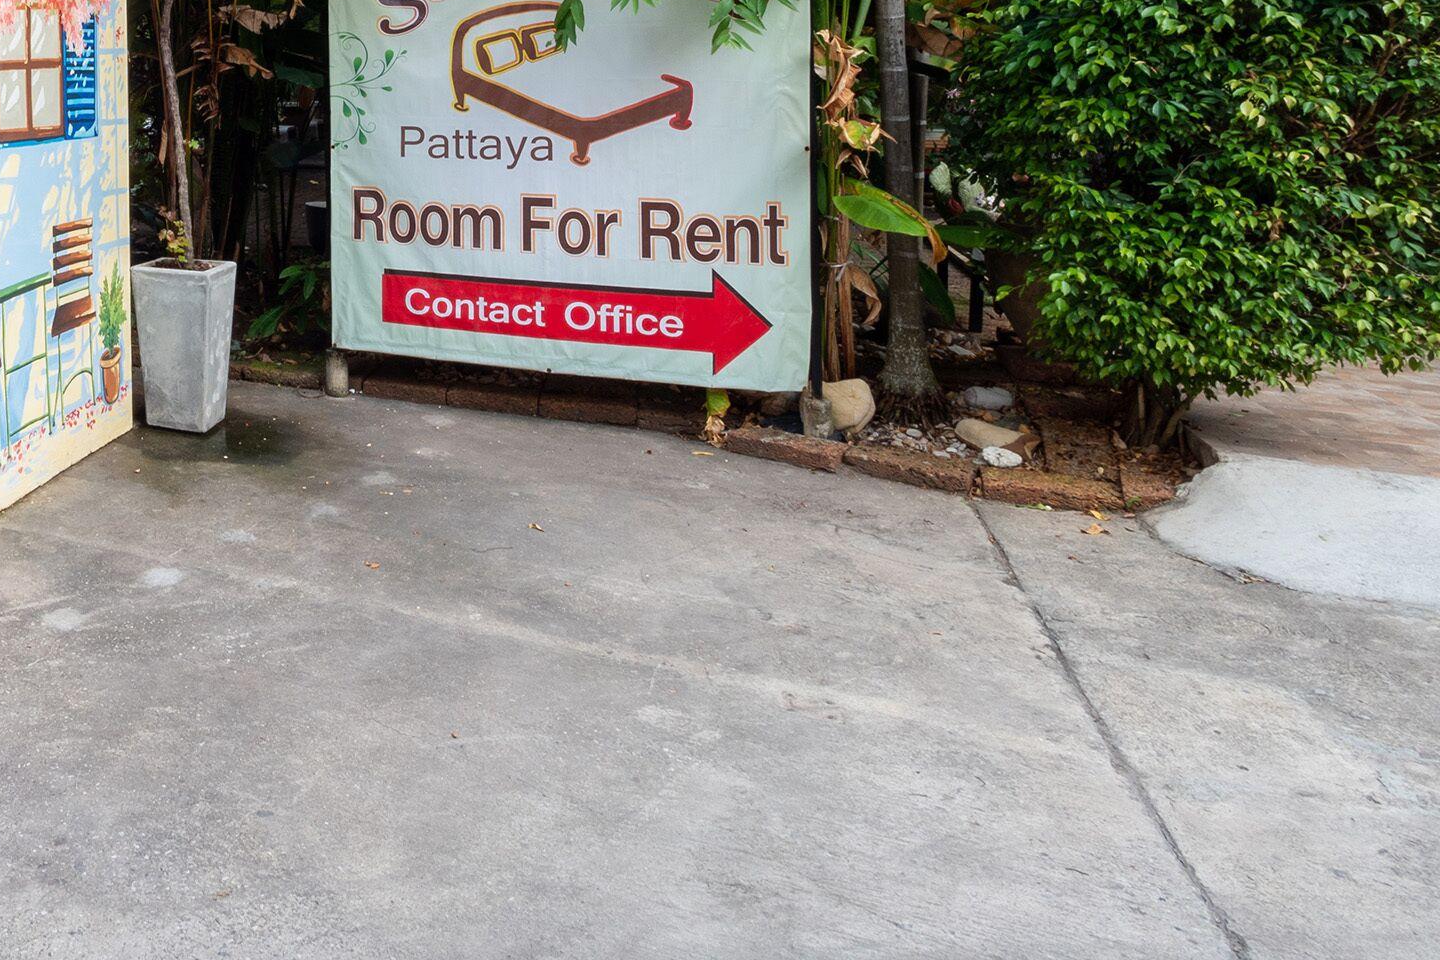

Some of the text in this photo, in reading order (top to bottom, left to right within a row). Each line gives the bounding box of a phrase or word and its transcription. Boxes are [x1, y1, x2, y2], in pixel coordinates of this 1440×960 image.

[400, 126, 554, 169] Pattaya
[351, 186, 789, 267] Room For Rent
[404, 288, 685, 338] Contact Office
